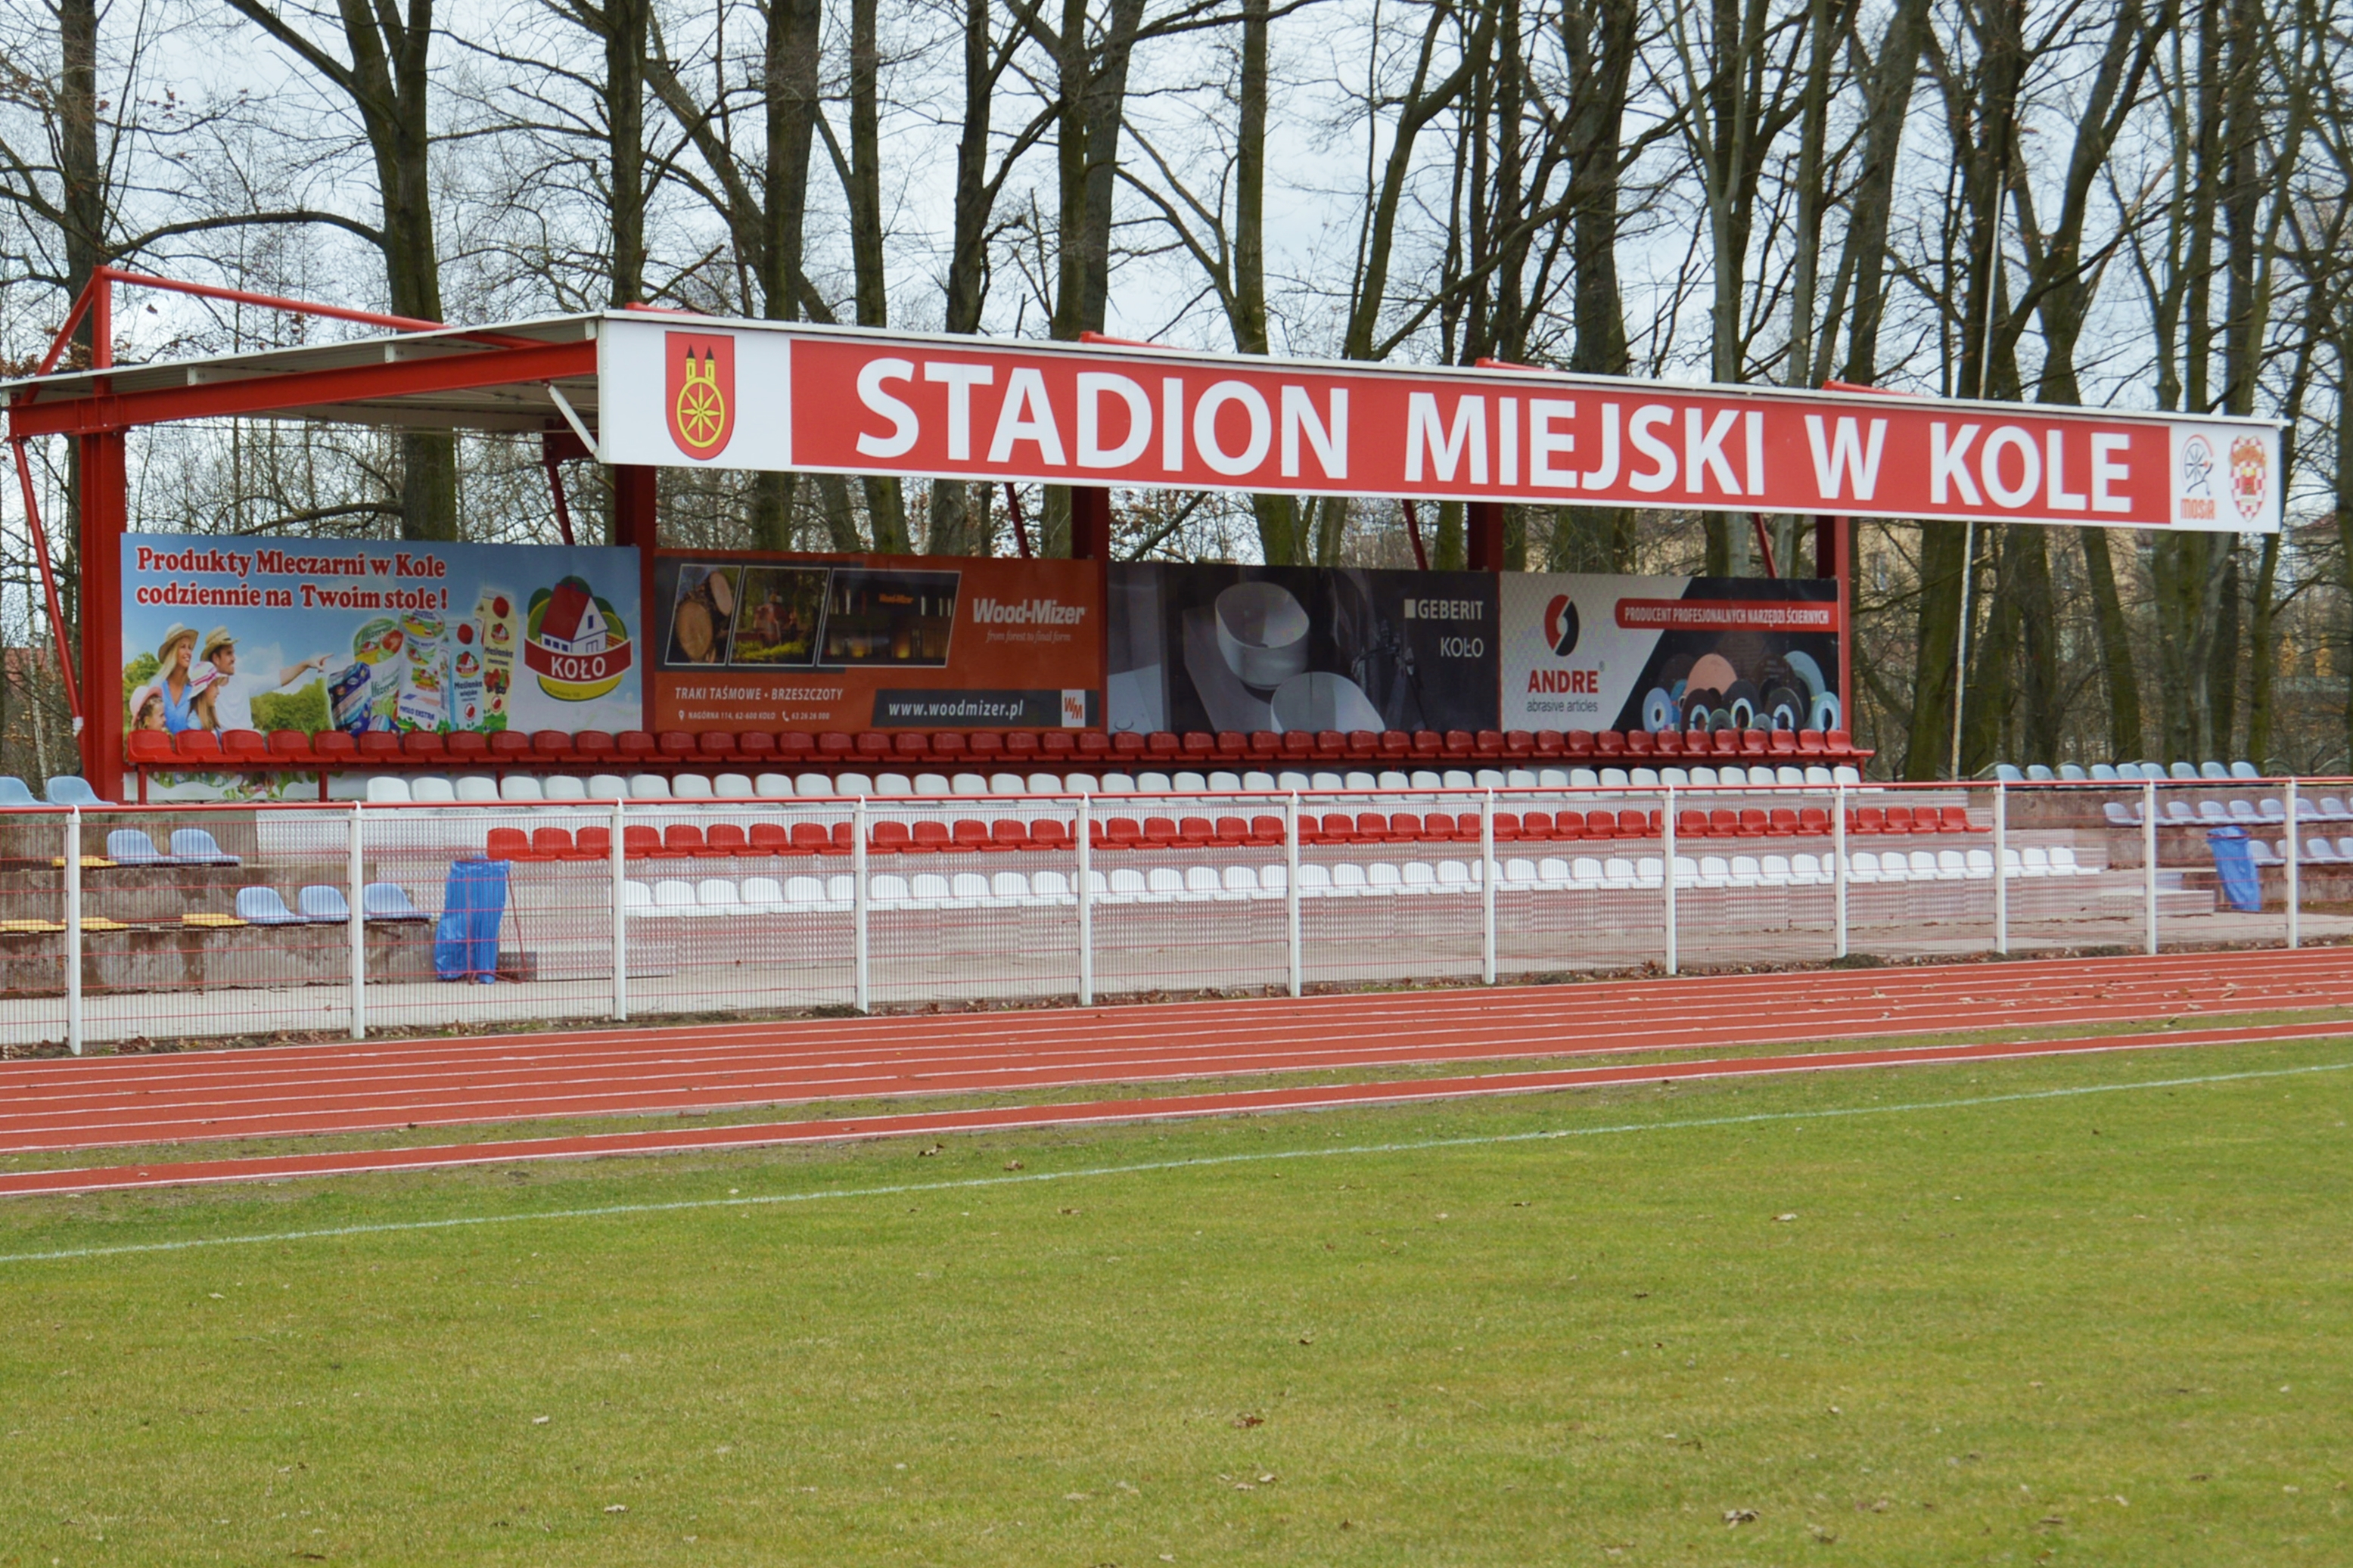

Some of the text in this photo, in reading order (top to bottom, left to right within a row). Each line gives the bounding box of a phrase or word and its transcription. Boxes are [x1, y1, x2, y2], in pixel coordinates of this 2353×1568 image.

[855, 357, 2132, 514] STADION MIEJSKI W KOLE
[137, 547, 446, 578] Produkty Mleczarni w Kole
[136, 582, 261, 606] codziennie
[265, 589, 293, 607] na
[300, 584, 381, 609] Twoim
[972, 598, 1085, 625] Wood-Mizer
[1418, 598, 1484, 619] GEBERIT
[1624, 607, 1830, 628] PRODUCENT PROFESJONALNYCH NARZĘDZI ŚCIERNYCH
[986, 629, 1071, 644] from forest to final form
[1440, 636, 1484, 657] KOŁO
[551, 655, 607, 679] KOŁO
[1527, 669, 1599, 694] ANDRE
[675, 685, 844, 701] TRAKI TAŚMOWE BRZESZCZOTY
[888, 699, 1024, 720] www.woodmizer.pl
[1526, 697, 1599, 713] abrasive articles
